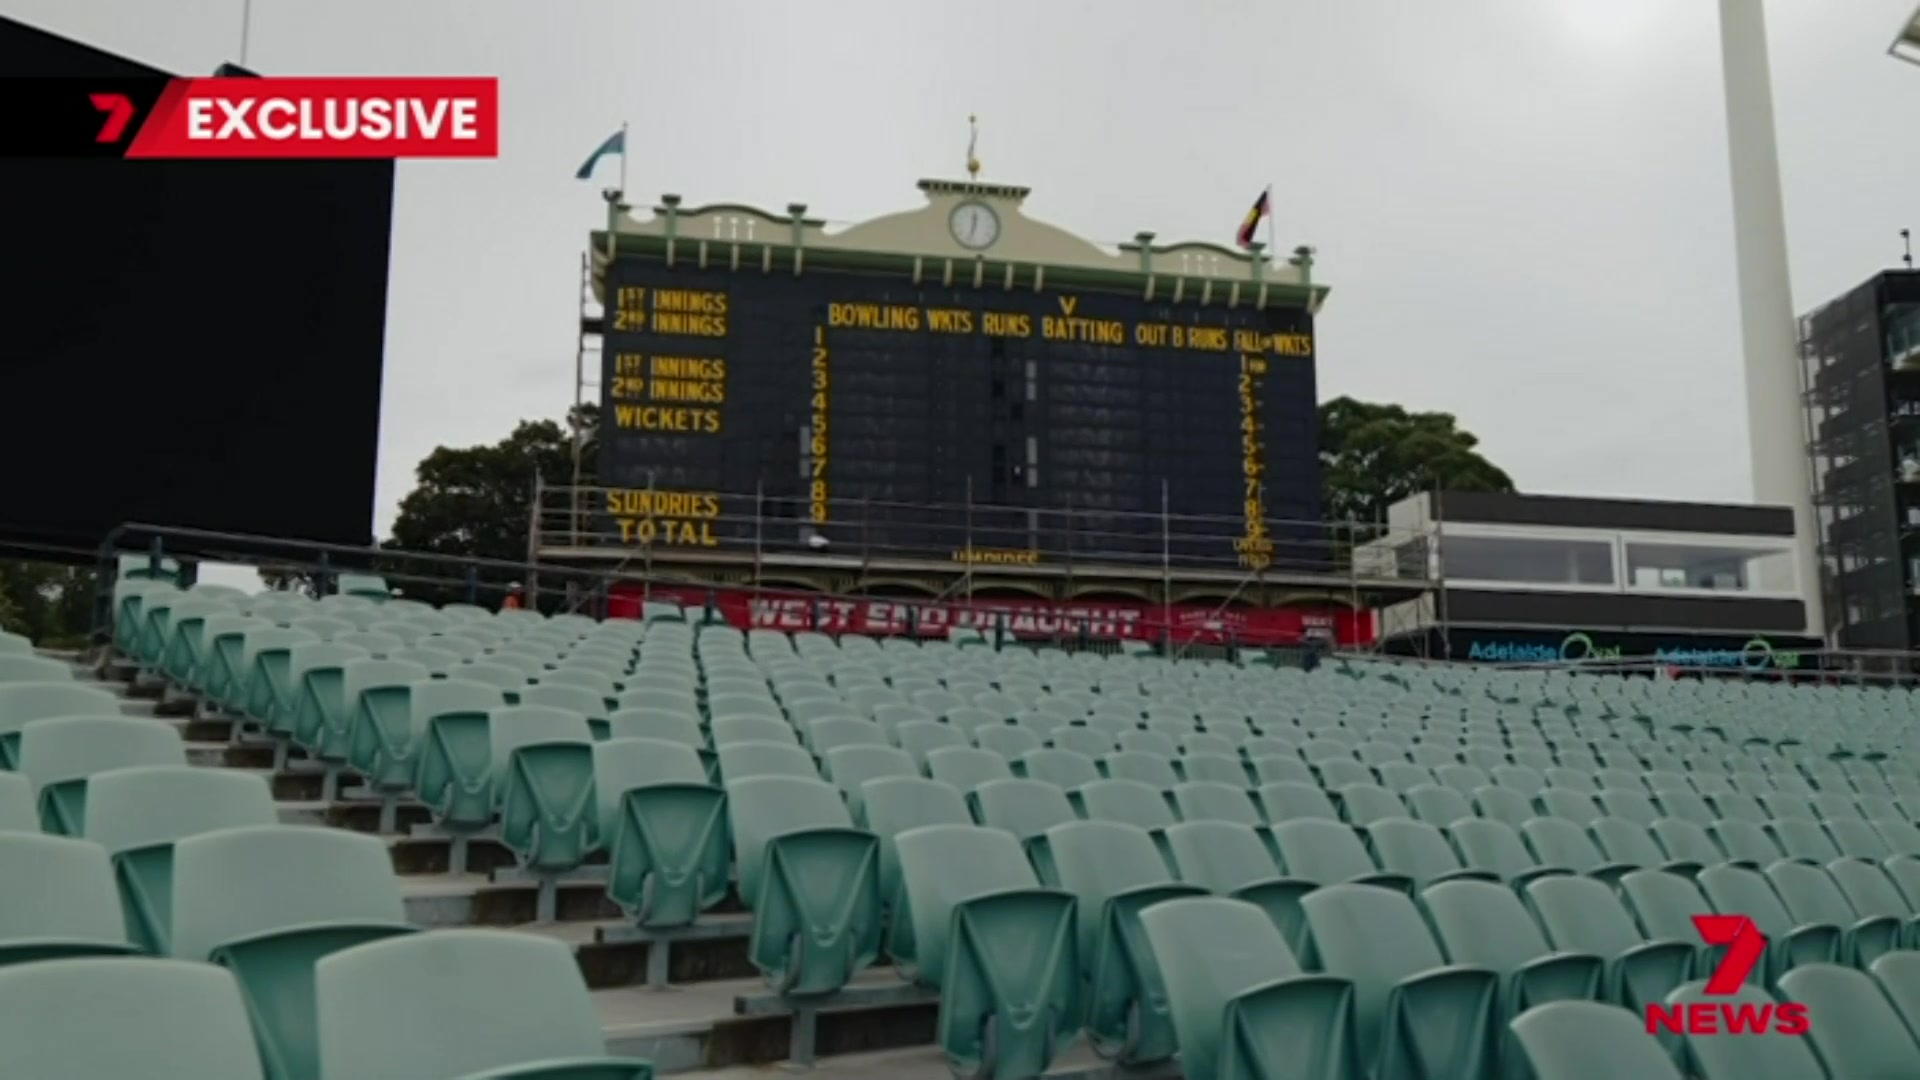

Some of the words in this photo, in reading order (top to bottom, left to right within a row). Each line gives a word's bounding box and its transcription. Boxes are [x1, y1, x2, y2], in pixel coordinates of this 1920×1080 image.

[653, 289, 727, 311] INNINGS
[1059, 297, 1078, 315] V
[653, 312, 727, 336] INNINGS
[828, 303, 920, 330] BOWLING
[927, 309, 973, 333] WKTS
[983, 313, 1031, 338] RUNS
[1042, 317, 1123, 344] BATTING
[1135, 324, 1167, 346] OUT
[1173, 328, 1184, 347] B
[1188, 329, 1228, 351] RUNS
[1233, 330, 1263, 352] FALL
[1273, 334, 1312, 356] WKTS
[814, 326, 825, 345] 1
[650, 355, 725, 379] INNINGS
[812, 348, 828, 368] 2
[812, 368, 828, 389] 3
[650, 379, 724, 401] INNINGS
[810, 392, 828, 411] 4
[615, 406, 720, 432] WICKETS
[811, 415, 828, 433] 5
[811, 435, 828, 456] 6
[810, 458, 828, 478] 7
[810, 481, 828, 500] 8
[606, 489, 720, 517] SUNDRIES
[809, 502, 828, 523] 9
[616, 520, 718, 546] TOTAL
[1468, 640, 1561, 661] Adelaide
[1655, 647, 1740, 667] Adelaide
